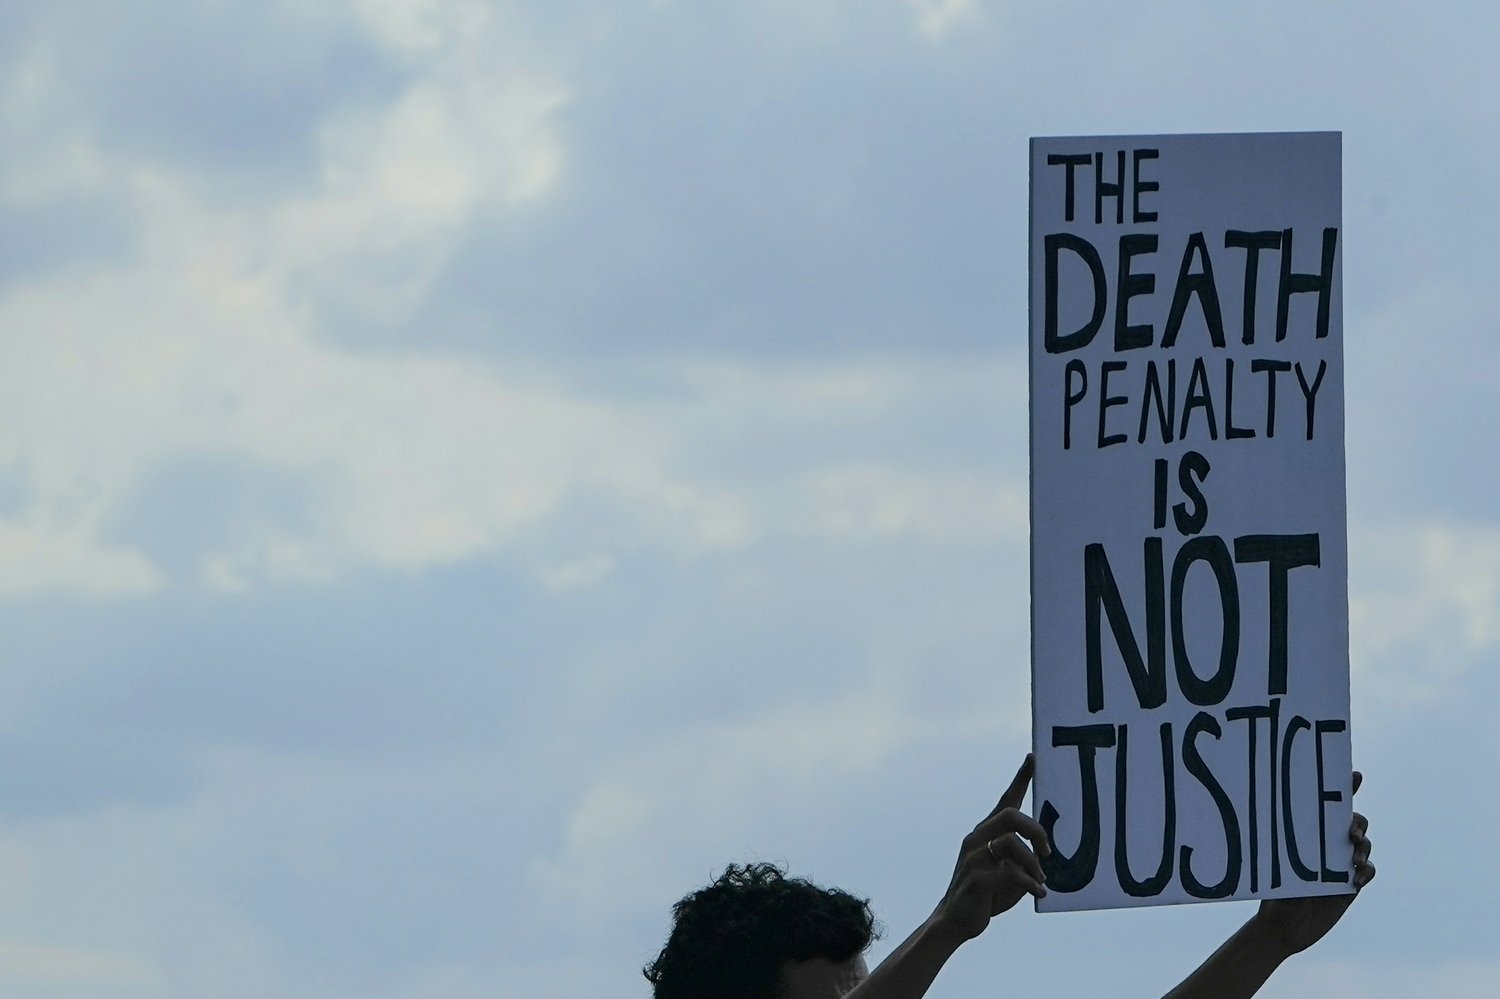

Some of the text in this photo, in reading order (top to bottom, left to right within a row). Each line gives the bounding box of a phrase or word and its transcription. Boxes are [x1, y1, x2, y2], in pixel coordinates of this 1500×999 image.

[1047, 149, 1160, 224] THE
[1043, 227, 1339, 354] DEATH
[1063, 358, 1328, 450] PENALTY
[1154, 451, 1212, 536] IS
[1084, 533, 1321, 713] NOT
[1038, 698, 1348, 899] JUSTICE
